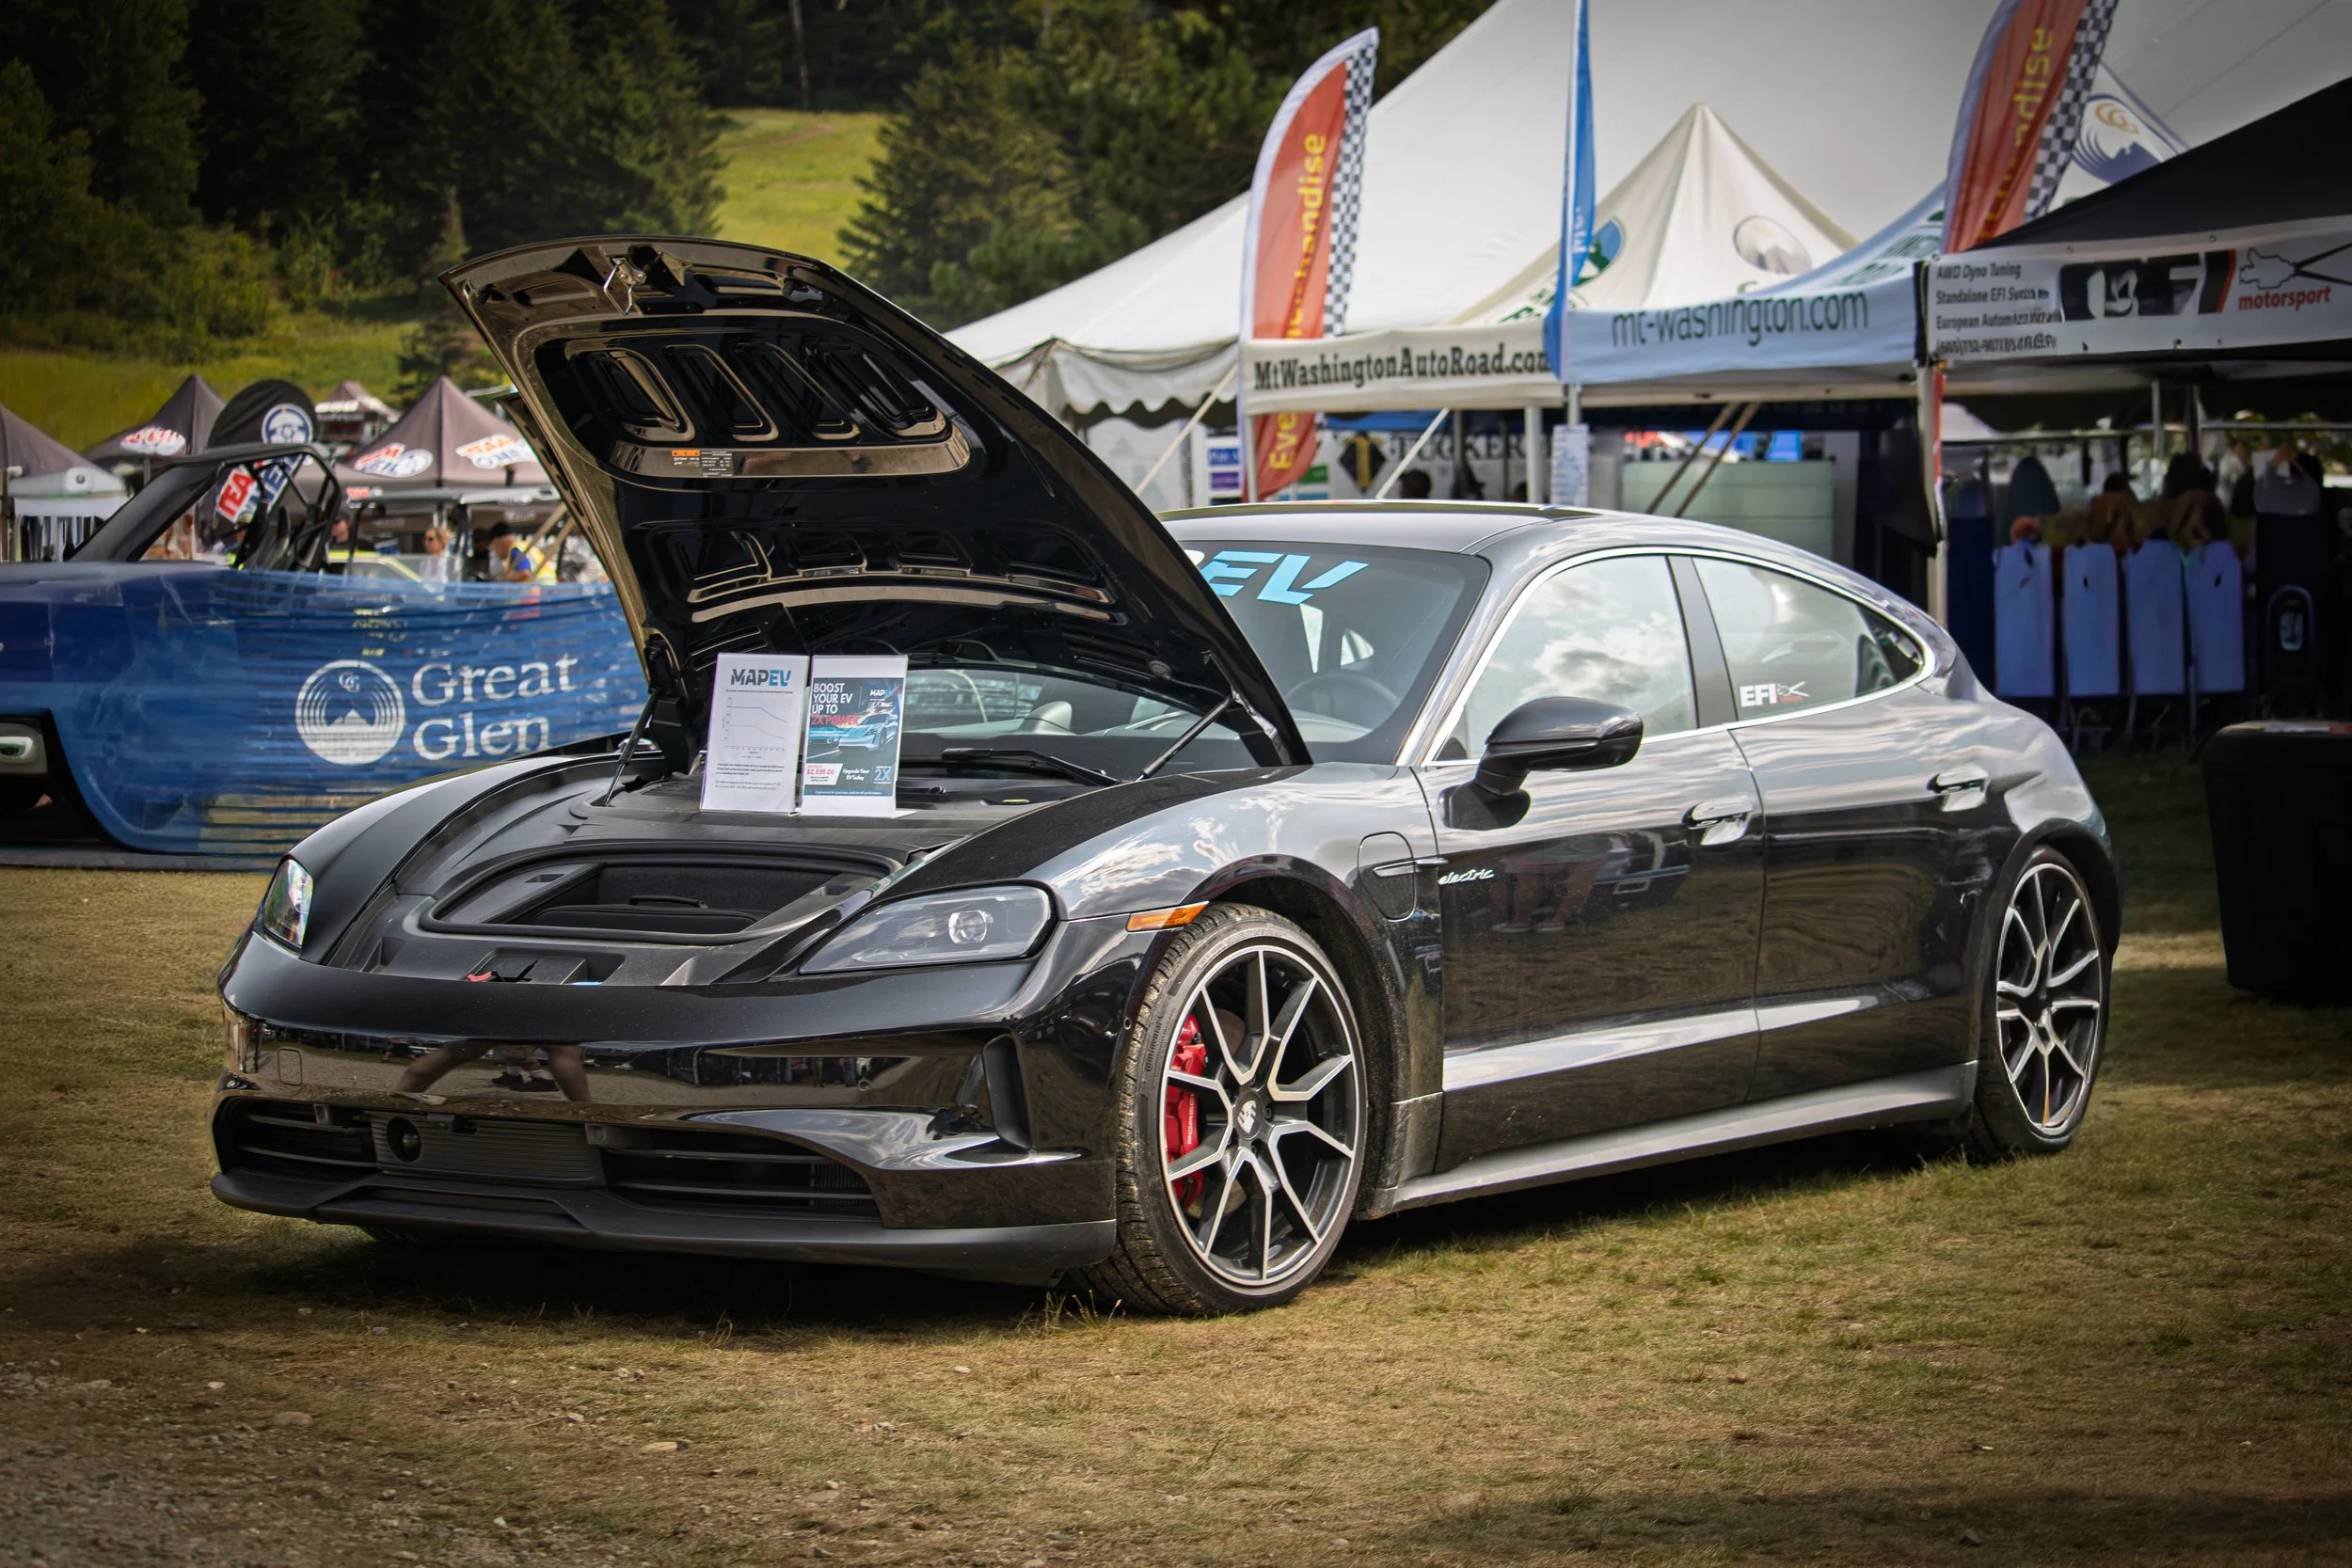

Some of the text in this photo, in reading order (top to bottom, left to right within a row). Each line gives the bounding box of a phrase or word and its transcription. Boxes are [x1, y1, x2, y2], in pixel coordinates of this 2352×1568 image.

[1936, 262, 2021, 281] AWD Dyno Tuning
[1935, 289, 1988, 304] Standalone
[1991, 287, 2006, 302] EFI
[2238, 285, 2331, 311] motorsport
[1936, 315, 1979, 332] European
[412, 653, 578, 705] Great
[730, 669, 791, 686] MAPEV
[813, 683, 845, 693] BOOST
[1740, 683, 1778, 707] EFI
[812, 693, 853, 705] YOUR EV
[812, 704, 838, 715] UP TO
[811, 715, 859, 725] 2X POWER
[413, 712, 552, 761] Glen
[873, 768, 891, 782] 2X
[1438, 868, 1495, 885] electric
